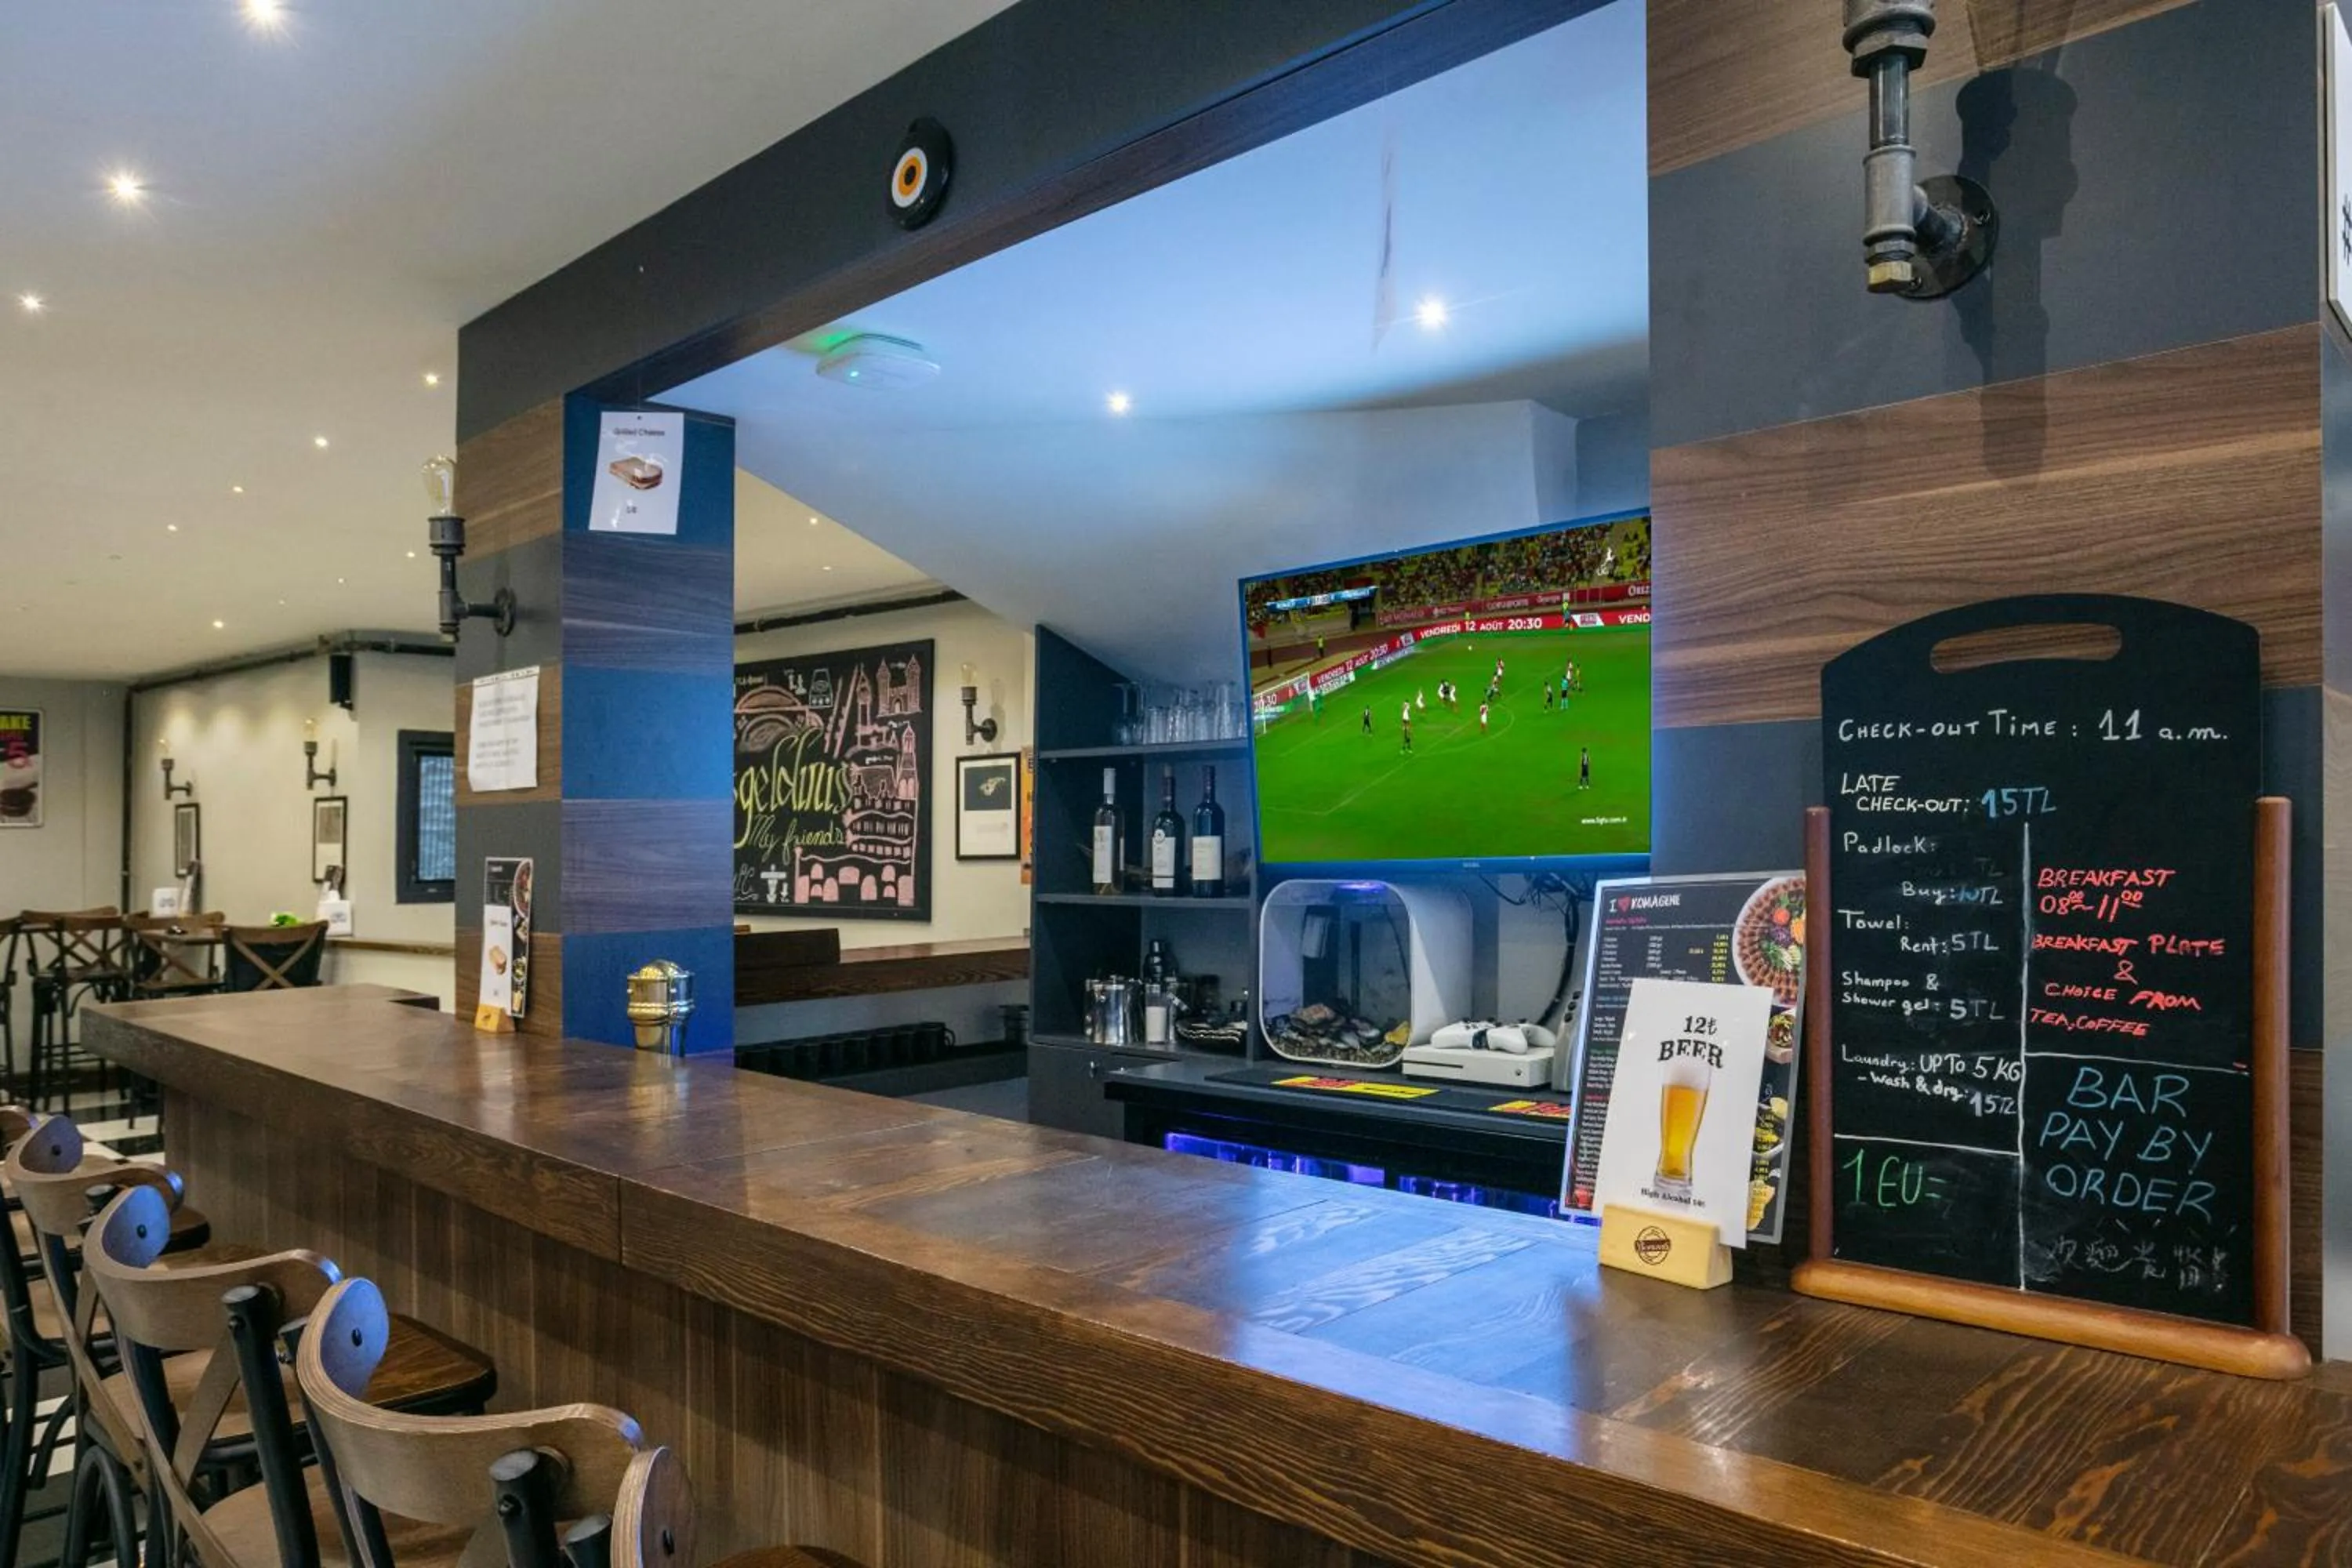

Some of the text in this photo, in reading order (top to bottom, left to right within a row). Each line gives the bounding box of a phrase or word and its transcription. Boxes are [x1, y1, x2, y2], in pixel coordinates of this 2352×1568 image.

[1420, 622, 1461, 639] VENDREDI
[1465, 620, 1477, 631] 12
[1508, 617, 1543, 630] 20:30
[1838, 718, 1979, 741] CHECK-OUT
[2098, 709, 2143, 741] 11
[2158, 726, 2229, 741] a.m.
[1841, 772, 1901, 795] LATE
[1856, 786, 2057, 818] CHECK-OUT: 15TL
[2038, 867, 2176, 889] BREAKFAST
[1630, 894, 1682, 910] KOMAGENE
[1837, 909, 1910, 930] Towel:
[2031, 933, 2227, 957] BREAKFAST PLATE
[1842, 970, 1940, 992] Shampoo &
[2114, 959, 2139, 985] &
[1842, 992, 1896, 1008] Shower
[2129, 989, 2202, 1011] FROM
[1657, 1039, 1724, 1069] BEER
[1842, 1044, 1916, 1073] Laundry:
[1973, 1055, 1996, 1079] 5
[1993, 1058, 2021, 1082] KG
[1915, 1075, 1931, 1096] &
[2067, 1066, 2190, 1118] BAR
[2039, 1111, 2214, 1169] PAY BY
[1842, 1148, 1865, 1205] 1
[2045, 1163, 2217, 1225] ORDER
